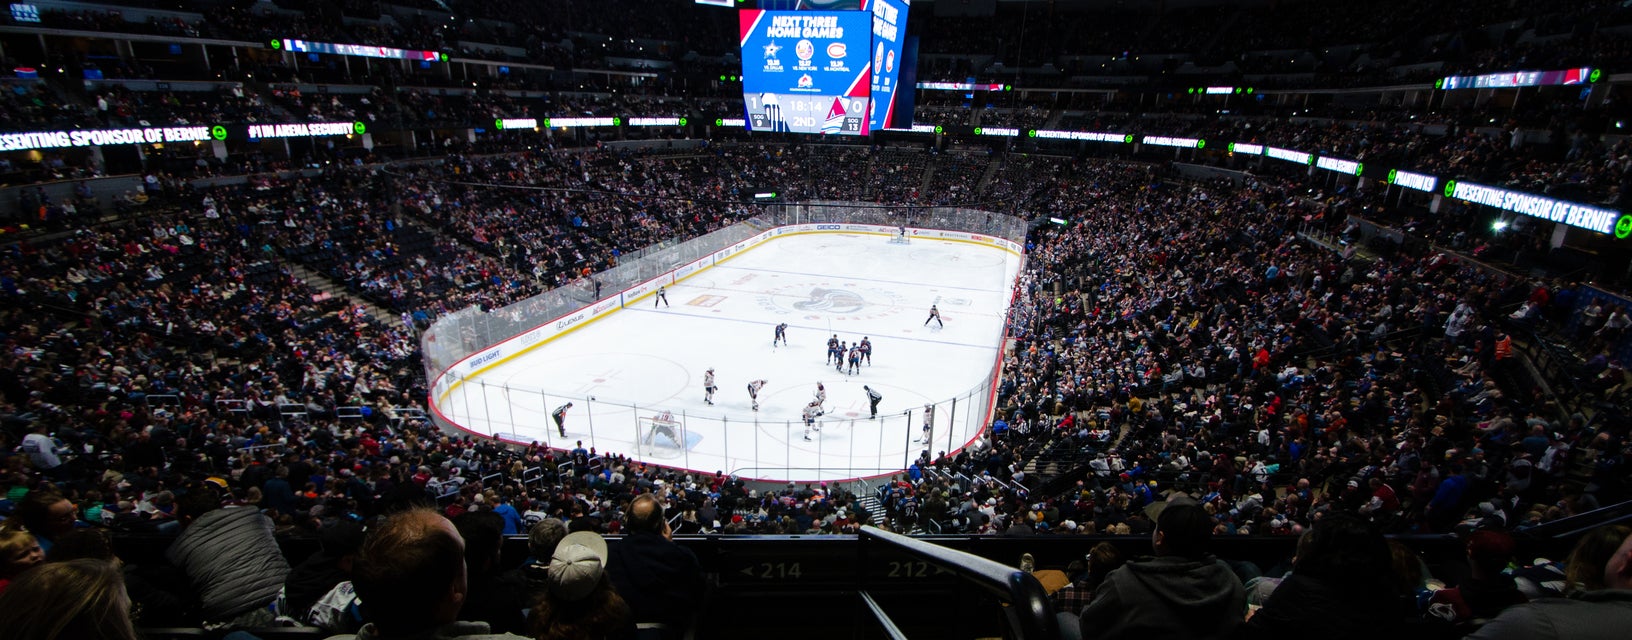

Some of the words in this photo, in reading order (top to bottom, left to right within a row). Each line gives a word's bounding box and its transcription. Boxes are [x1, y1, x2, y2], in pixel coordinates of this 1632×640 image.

[772, 15, 801, 27] NEXT
[802, 16, 838, 28] THREE
[766, 26, 801, 38] HOME
[802, 26, 844, 38] GAMES
[751, 96, 757, 109] 1
[790, 100, 822, 111] 18:14
[852, 100, 863, 113] 0
[793, 116, 816, 127] 2ND
[848, 123, 858, 131] 13
[248, 125, 260, 138] #1
[260, 125, 275, 138] IN
[275, 124, 309, 138] ARENA
[308, 122, 354, 136] SECURITY
[912, 125, 935, 133] ECURITY
[981, 127, 1010, 136] PHANTOM
[1036, 130, 1071, 139] PRESENTING
[1071, 131, 1097, 140] SPONSOR
[1097, 133, 1105, 141] OF
[69, 128, 145, 147] SPONSOR
[144, 127, 163, 143] OF
[162, 126, 211, 142] BERNIE
[1172, 138, 1199, 148] SECURITY
[1393, 170, 1425, 191] PHANTOM
[1421, 176, 1435, 193] K9
[1452, 181, 1504, 208] PRESENTING
[1502, 192, 1554, 219] SPONSOR
[1550, 201, 1570, 222] OF
[1565, 205, 1616, 234] BERNIE
[562, 314, 584, 327] LEXUS
[470, 357, 483, 368] BUD
[482, 350, 500, 363] LIGHT
[761, 562, 802, 579] 214
[888, 561, 928, 578] 212
